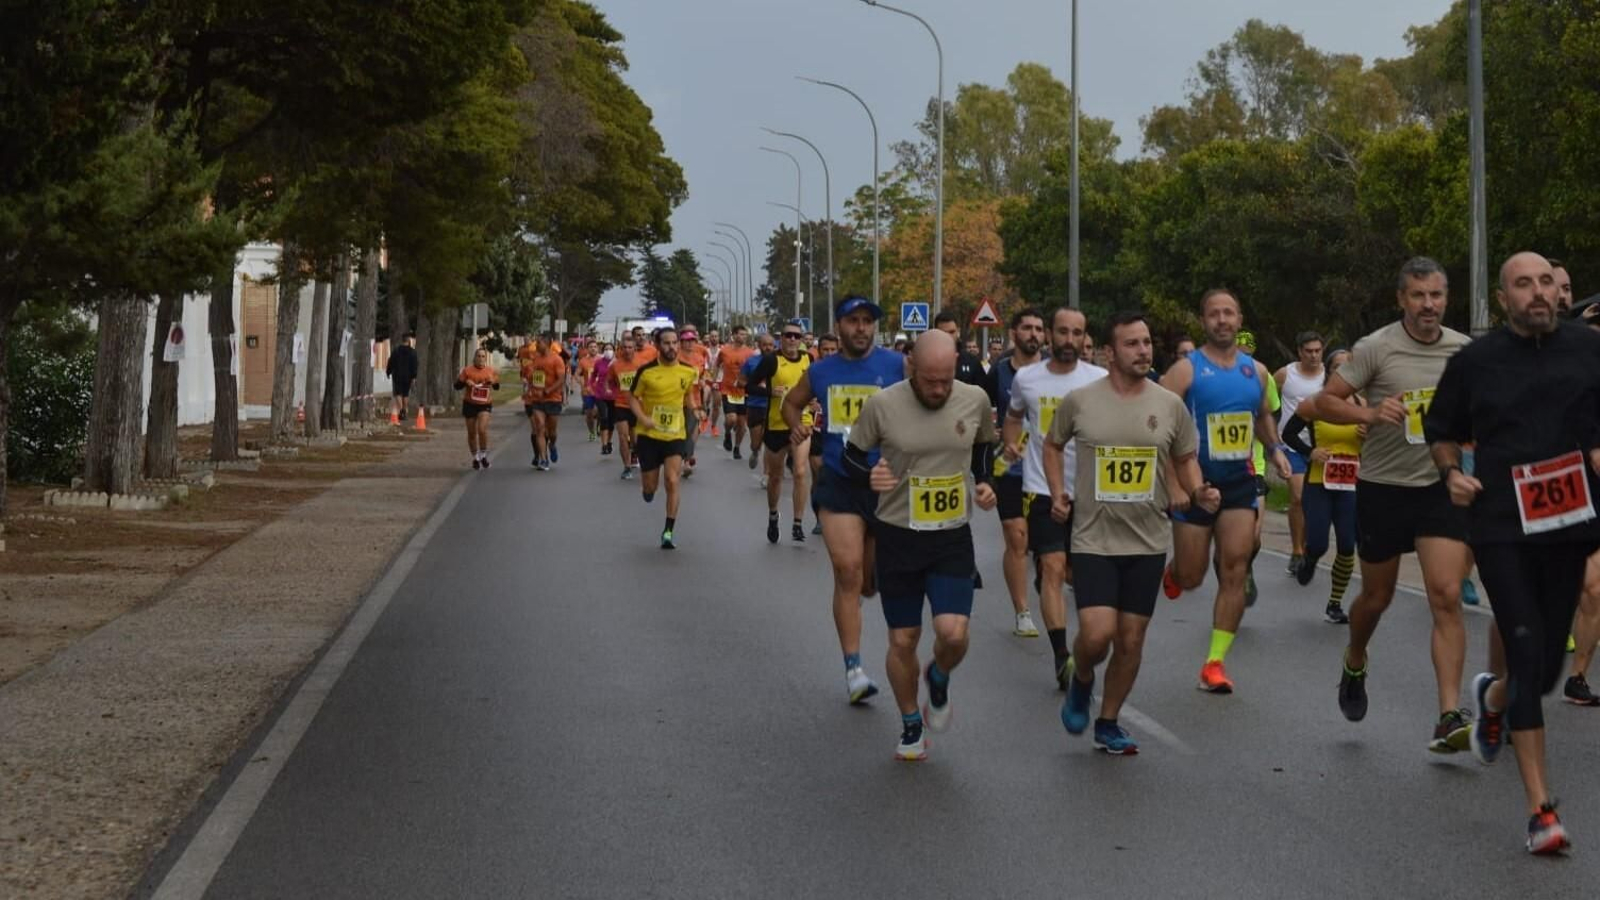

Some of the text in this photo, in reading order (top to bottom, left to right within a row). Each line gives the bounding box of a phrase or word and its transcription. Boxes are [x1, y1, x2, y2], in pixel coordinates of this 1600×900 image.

[842, 397, 864, 417] 11
[660, 412, 673, 425] 93
[1217, 425, 1247, 445] 197
[1106, 460, 1147, 484] 187
[1329, 462, 1356, 479] 293
[920, 488, 960, 513] 186
[1528, 472, 1577, 510] 261
